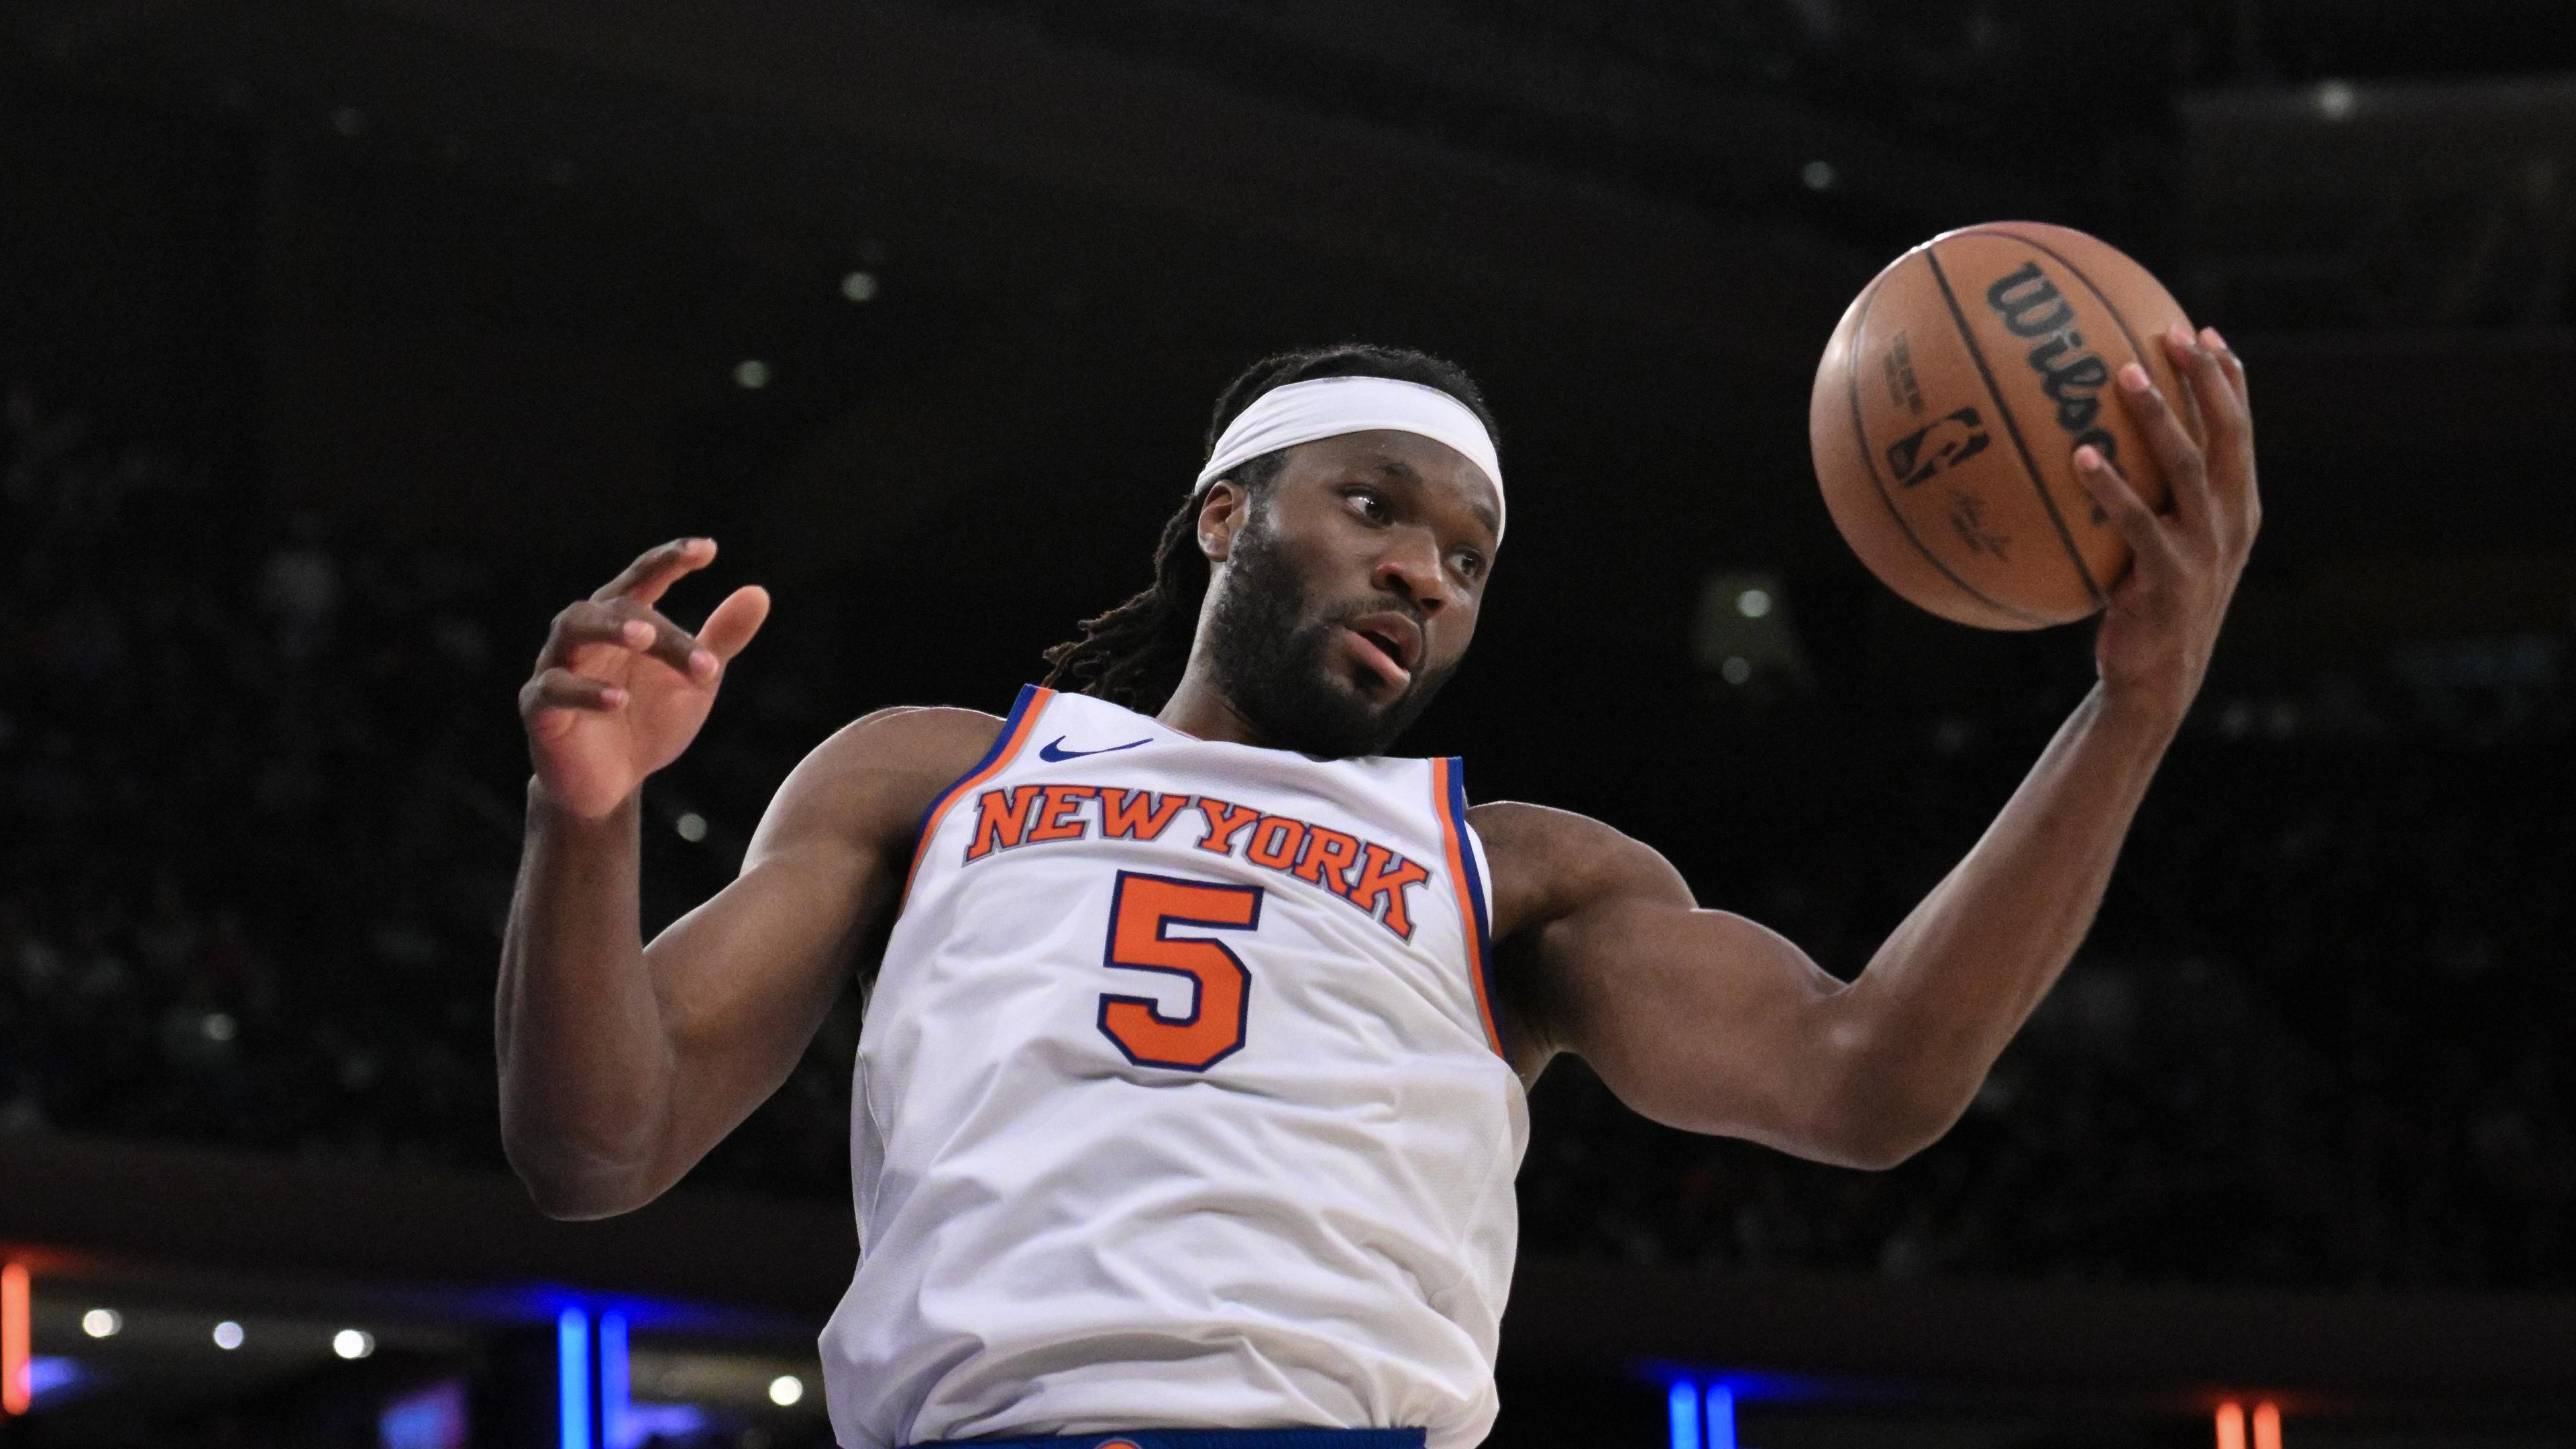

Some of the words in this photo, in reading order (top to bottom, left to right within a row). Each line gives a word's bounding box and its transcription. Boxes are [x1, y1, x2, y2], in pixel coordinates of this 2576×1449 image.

[963, 784, 1189, 865] NEW
[1196, 796, 1430, 943] YORK
[1097, 870, 1264, 1073] 5
